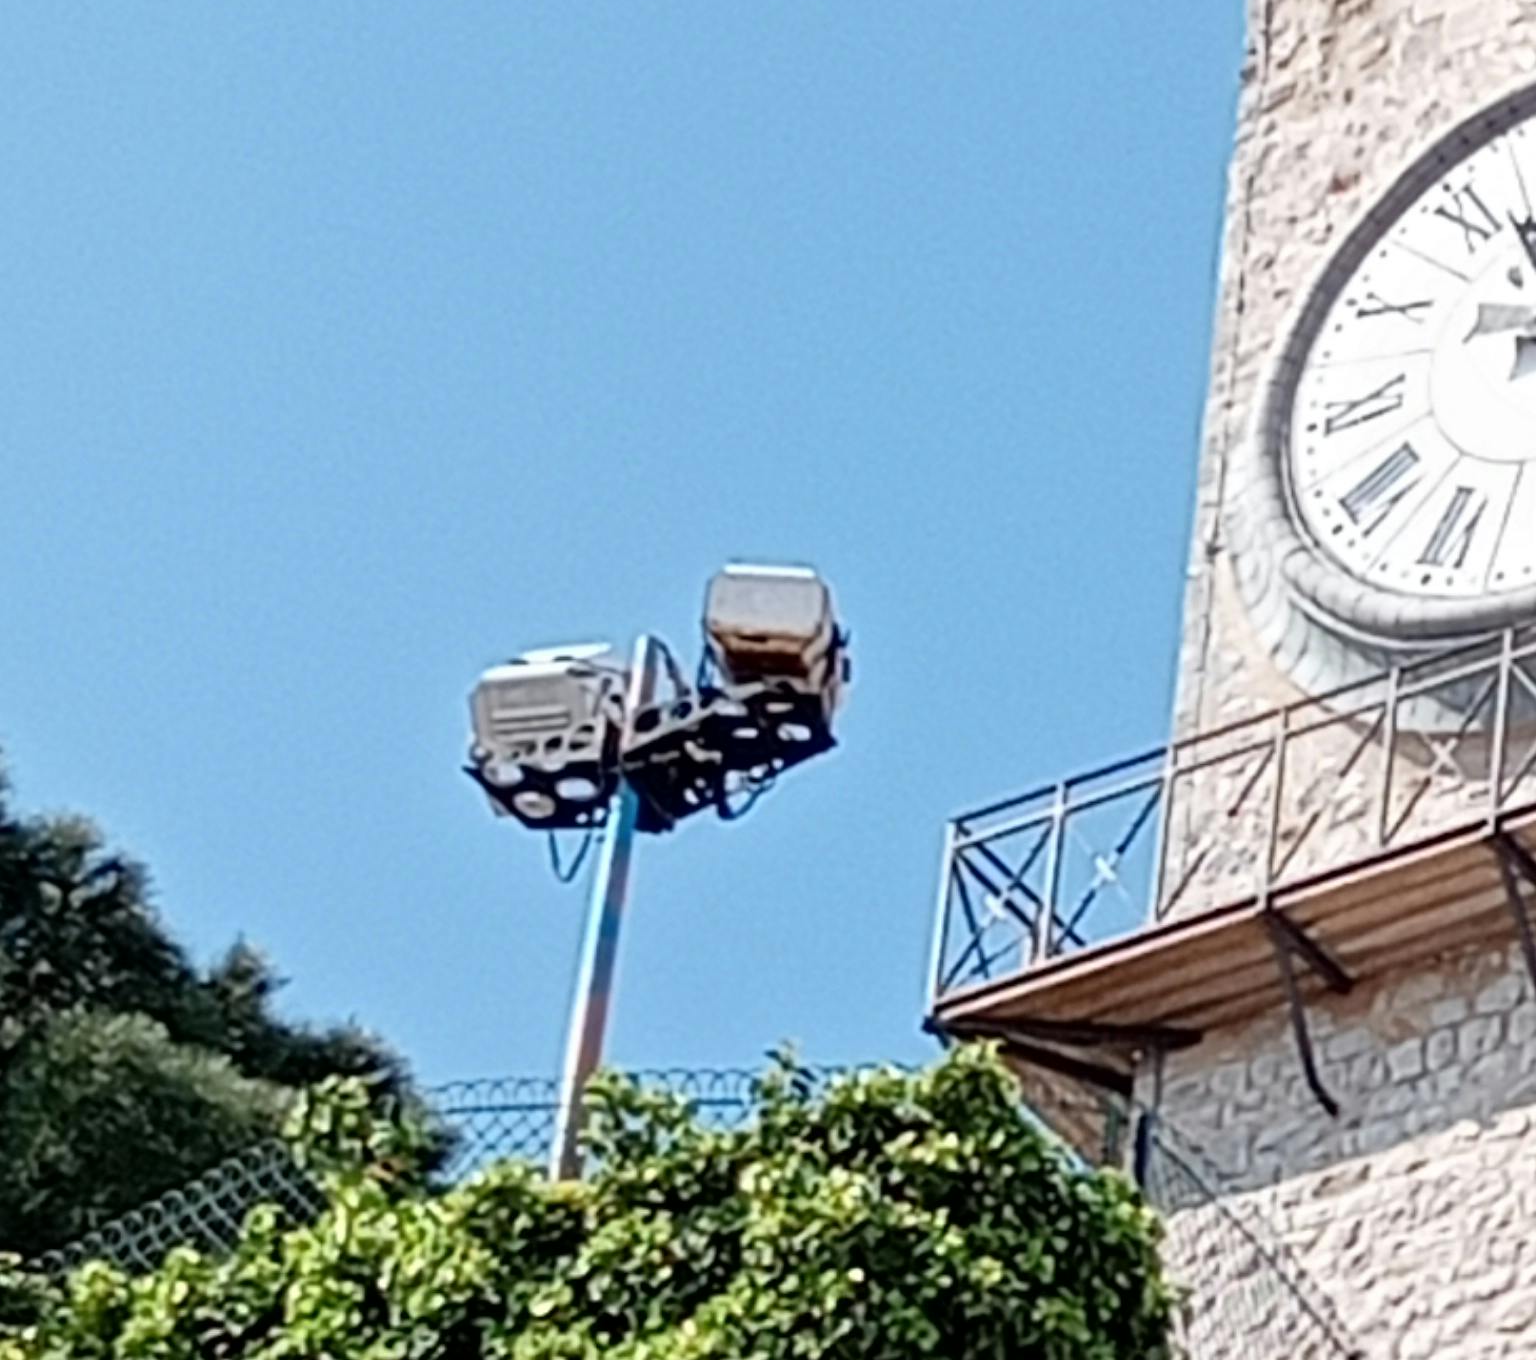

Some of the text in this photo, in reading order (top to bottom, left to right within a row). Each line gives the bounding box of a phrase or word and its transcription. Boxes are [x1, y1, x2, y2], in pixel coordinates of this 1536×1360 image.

[1434, 182, 1503, 253] XI
[1355, 292, 1435, 325] X
[1324, 373, 1406, 437] IX
[1339, 440, 1429, 537] VIII
[1415, 485, 1488, 569] VII
